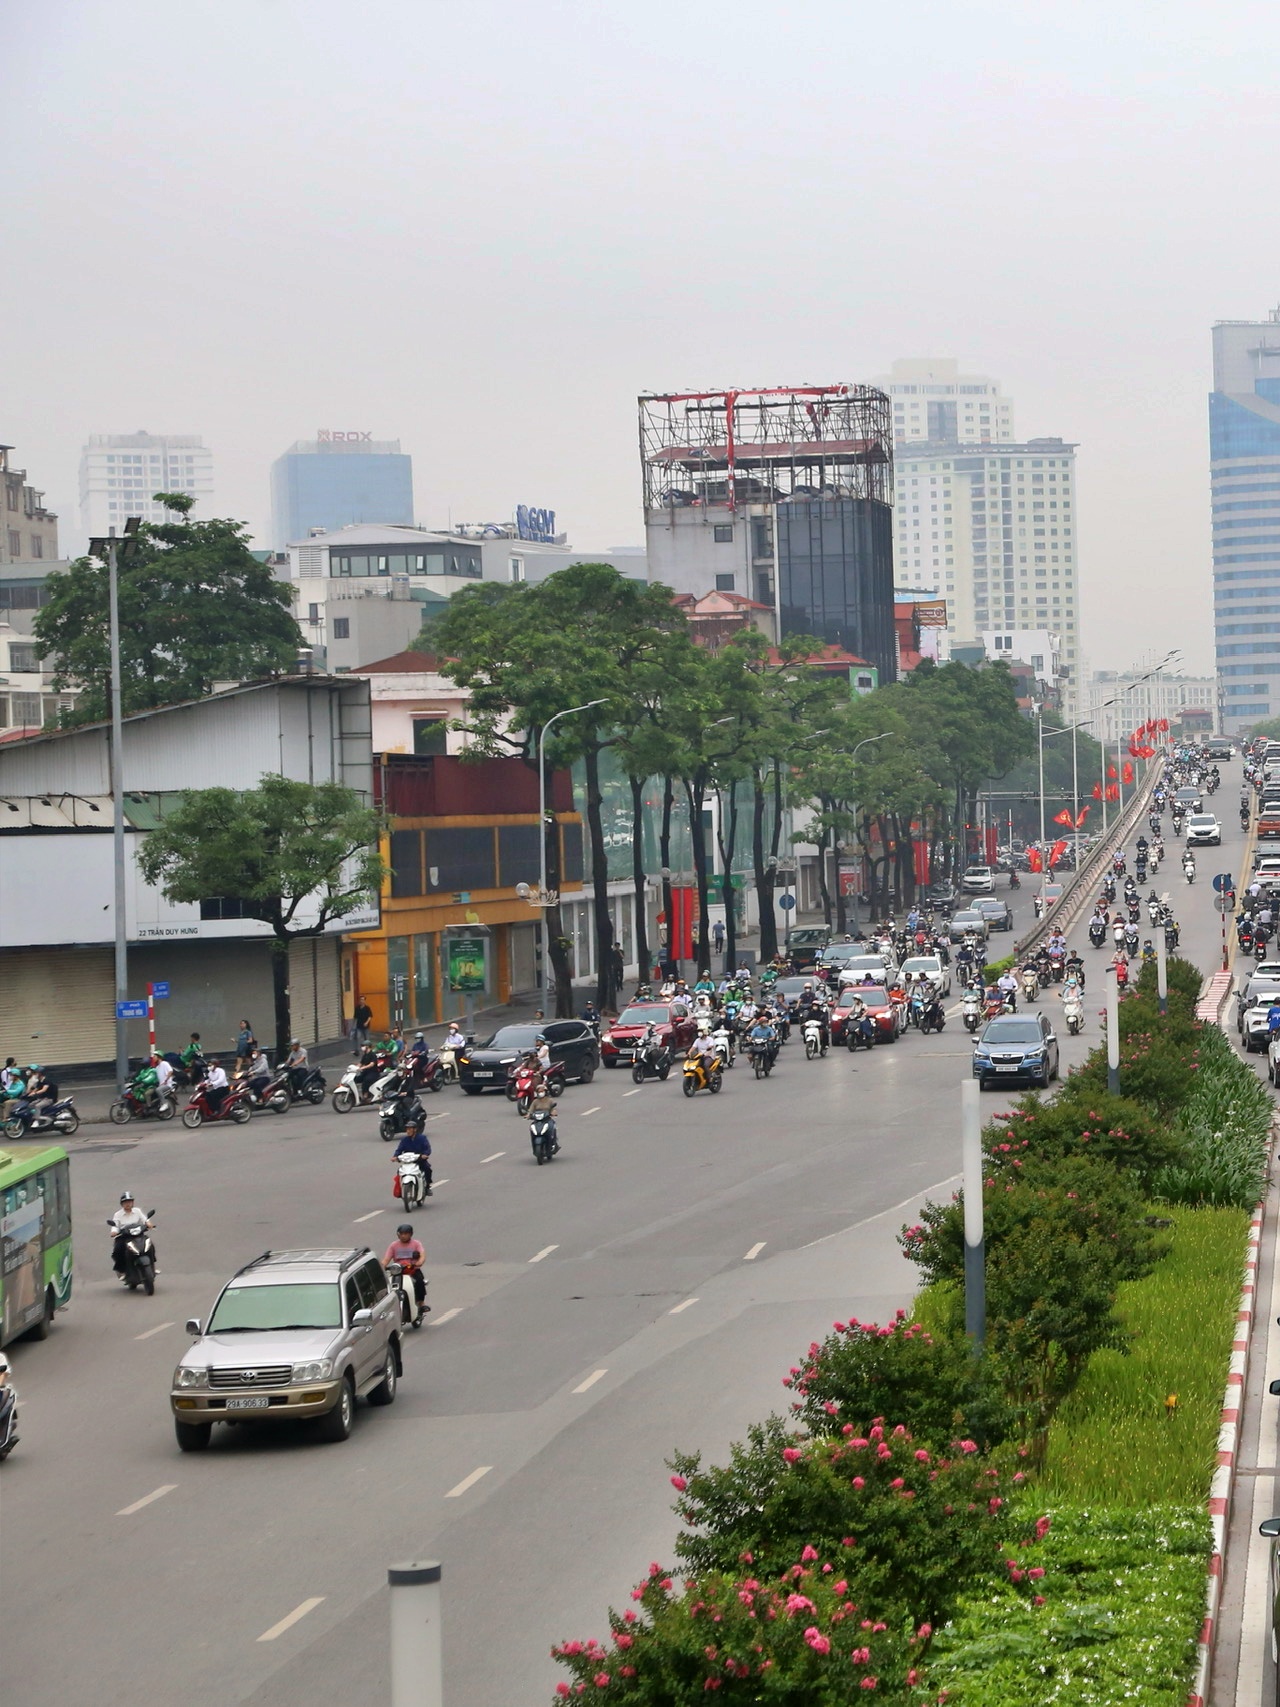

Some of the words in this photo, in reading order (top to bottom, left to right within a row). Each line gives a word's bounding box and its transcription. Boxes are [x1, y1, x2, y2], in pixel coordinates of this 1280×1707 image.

[138, 929, 147, 937] 22
[147, 926, 164, 936] TRẦN
[165, 928, 179, 936] DUY
